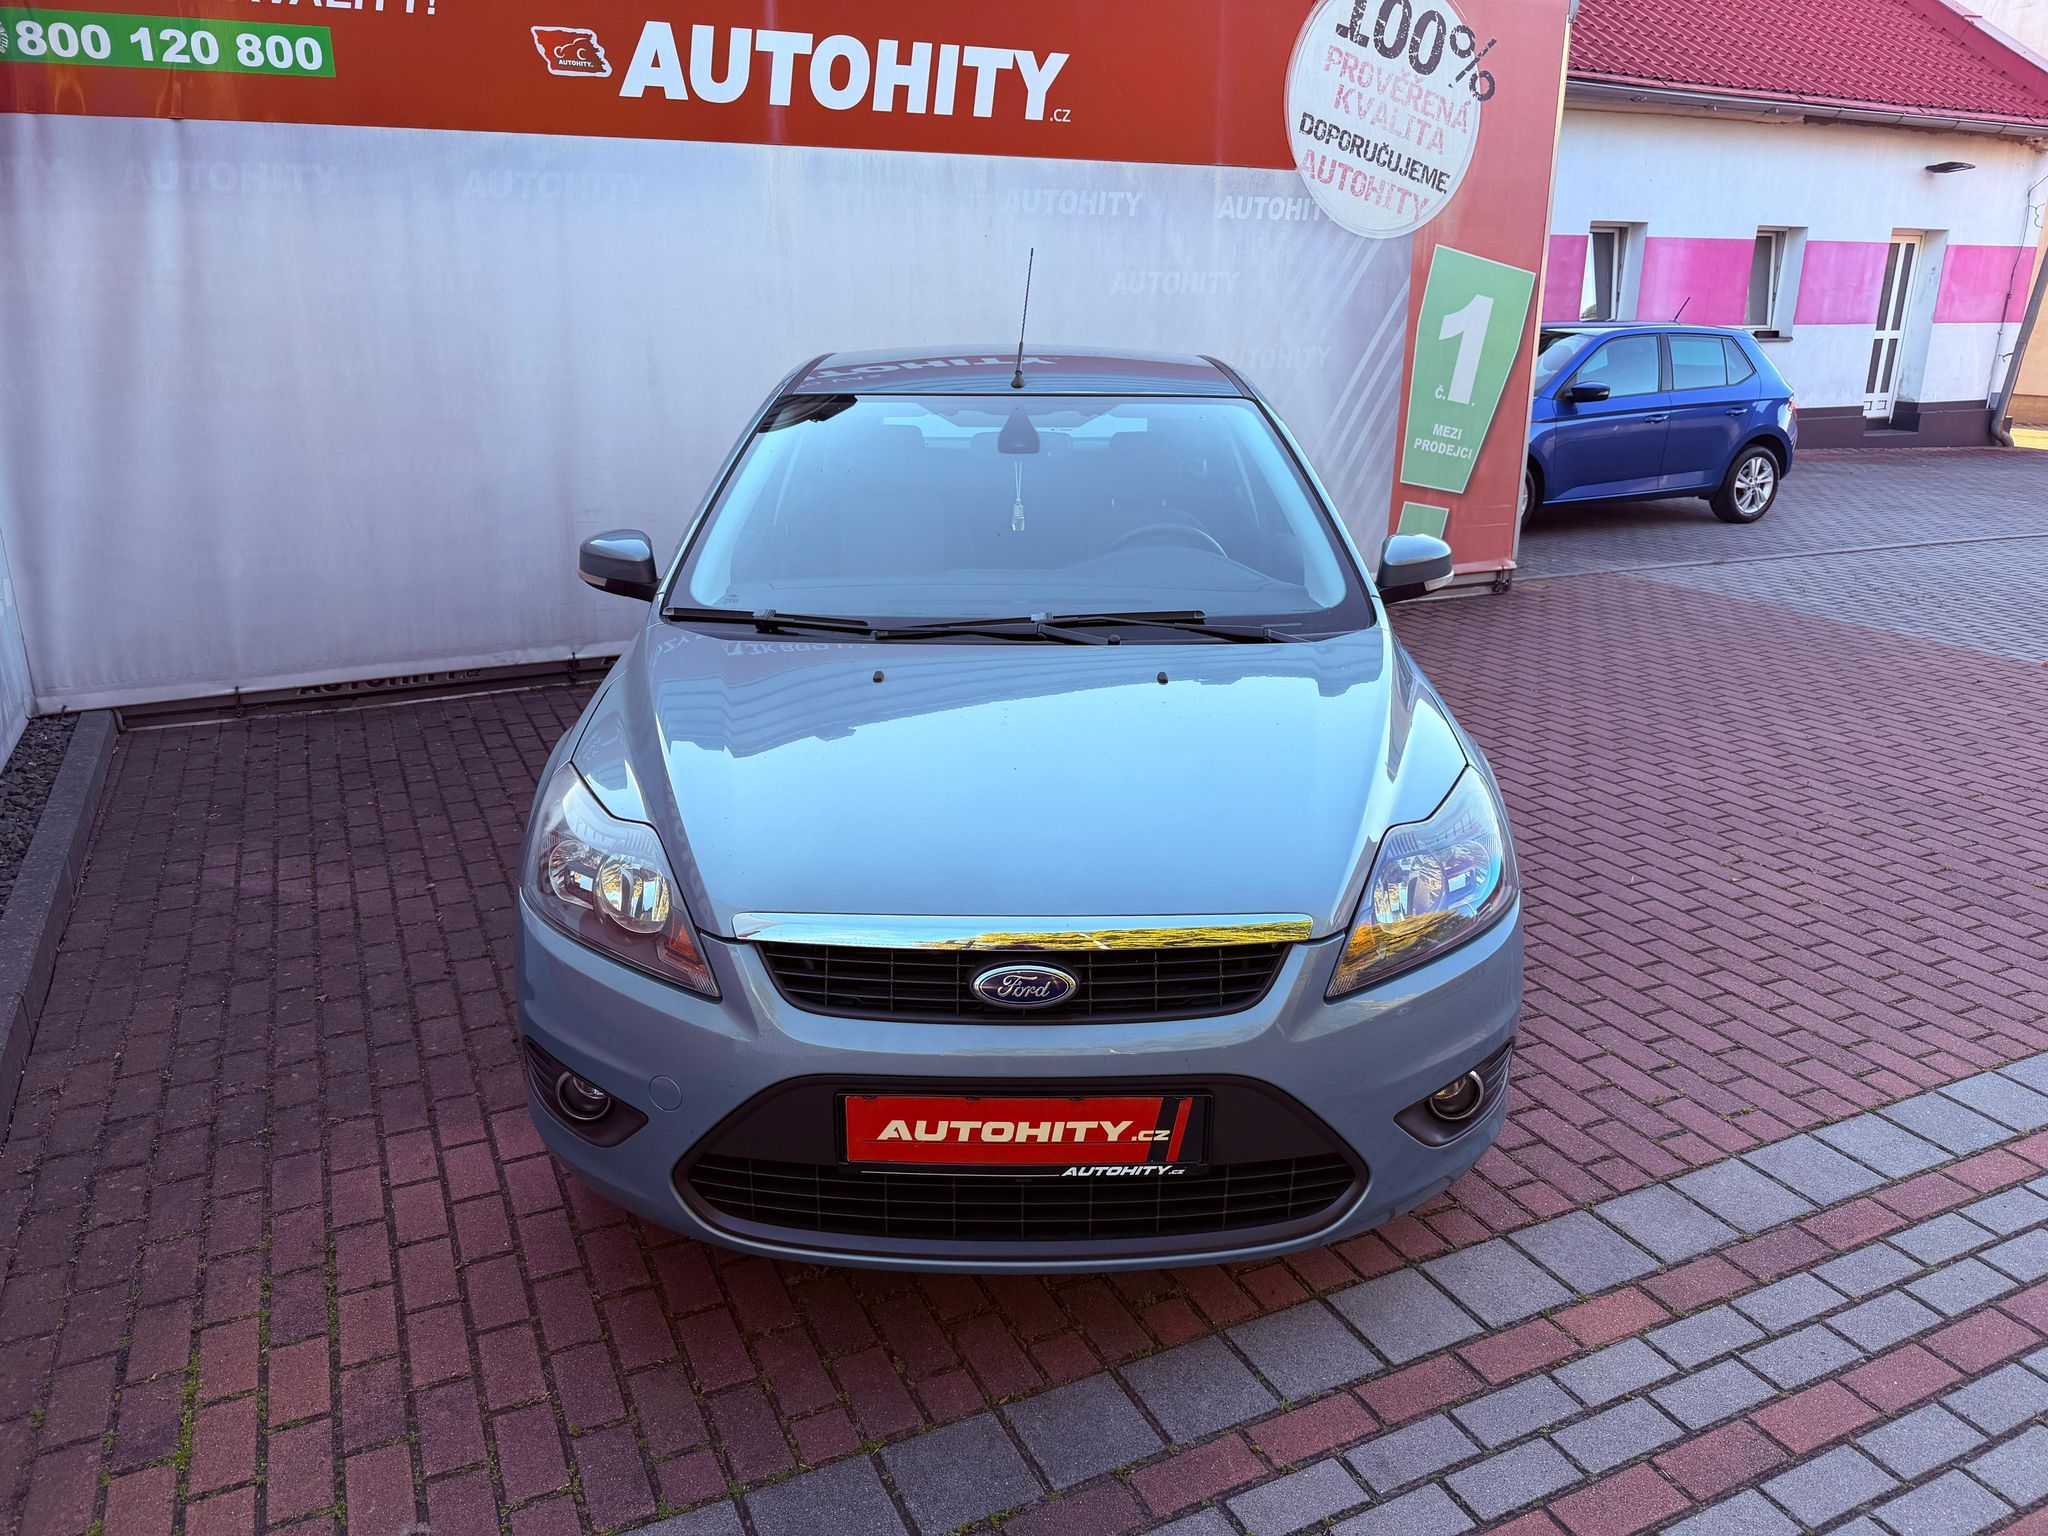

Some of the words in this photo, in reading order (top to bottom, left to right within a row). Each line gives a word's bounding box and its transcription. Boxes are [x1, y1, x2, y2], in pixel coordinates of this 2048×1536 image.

[15, 20, 112, 59] 800
[130, 26, 219, 64] 120
[236, 34, 323, 70] 800
[1336, 0, 1497, 101] 100%
[1324, 45, 1471, 134] PROVĚŘENÁ
[1334, 84, 1443, 155] KVALITA
[1299, 112, 1451, 194] DOPORUČUJEME
[1002, 188, 1143, 217] AUTOHITY
[1301, 149, 1429, 222] AUTOHITY
[1218, 195, 1330, 221] AUTOHIT
[1109, 271, 1240, 295] AUTOHITY
[1413, 437, 1474, 461] PRODEJCI
[1433, 423, 1462, 441] MEZI
[997, 973, 1050, 999] Ford
